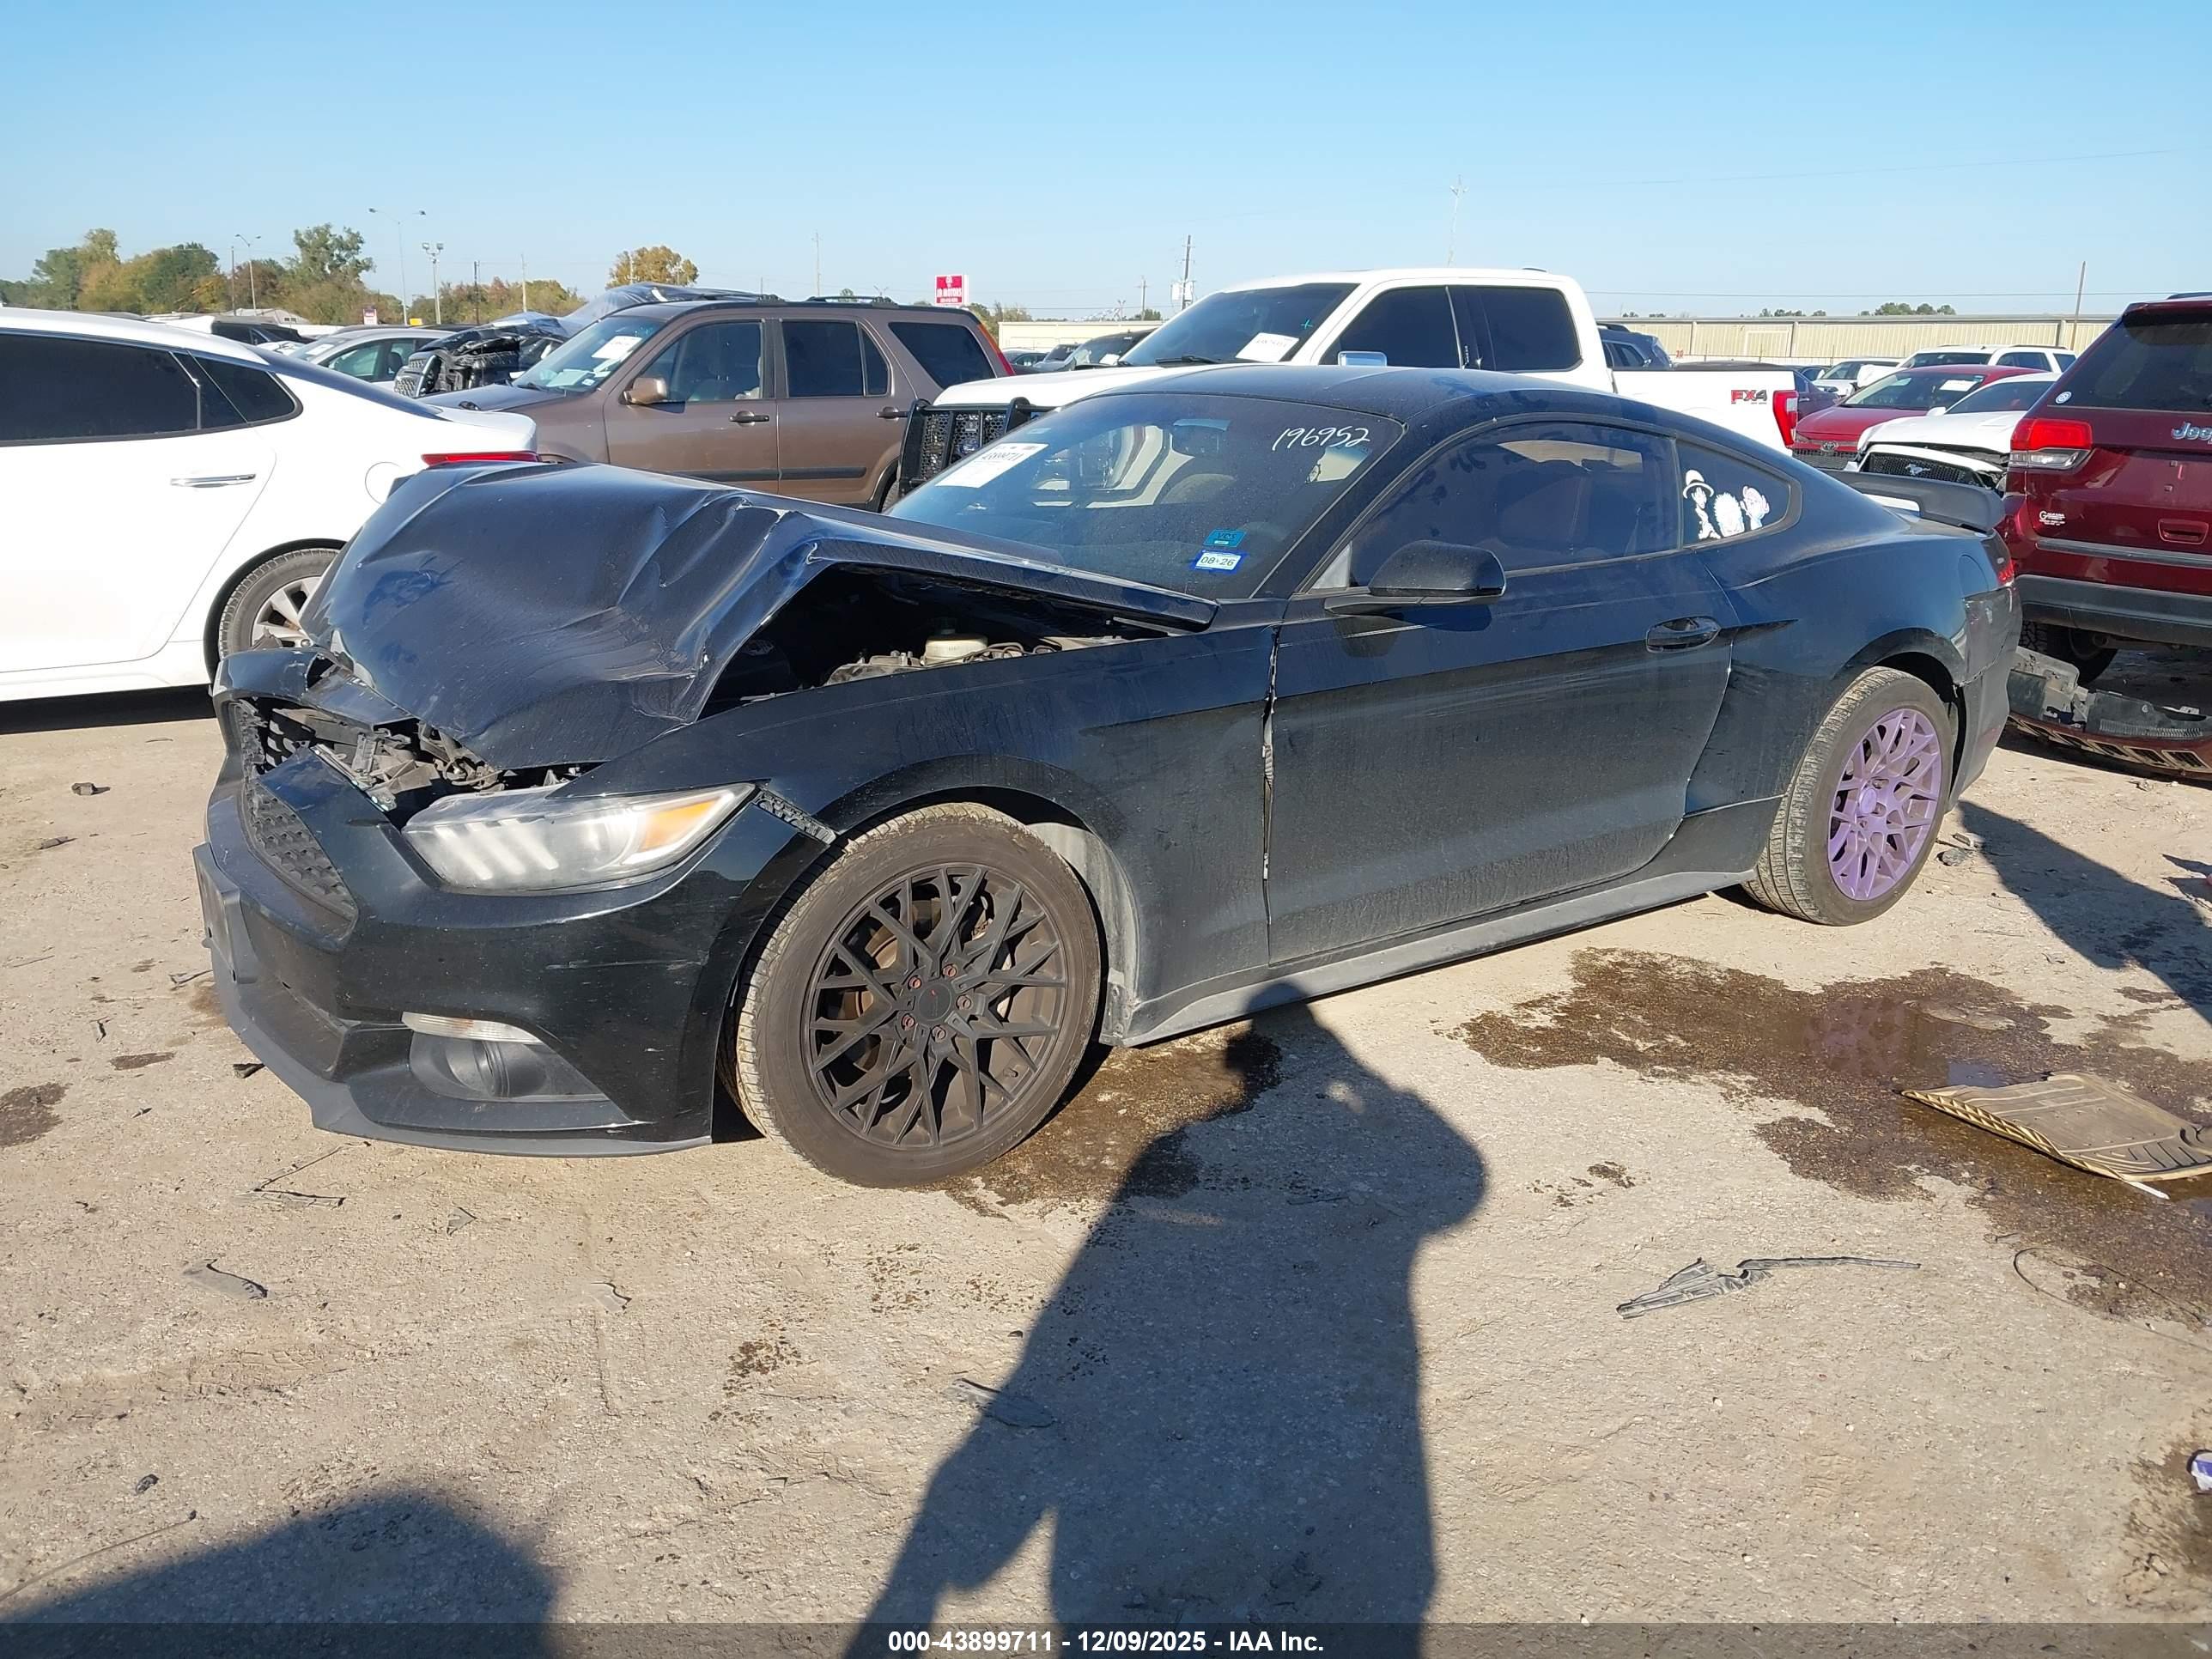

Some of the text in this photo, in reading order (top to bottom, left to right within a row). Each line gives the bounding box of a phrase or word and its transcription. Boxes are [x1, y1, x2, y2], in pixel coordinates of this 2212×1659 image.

[1730, 389, 1768, 402] FX4
[1272, 425, 1370, 452] 196952
[2171, 421, 2212, 445] Jee
